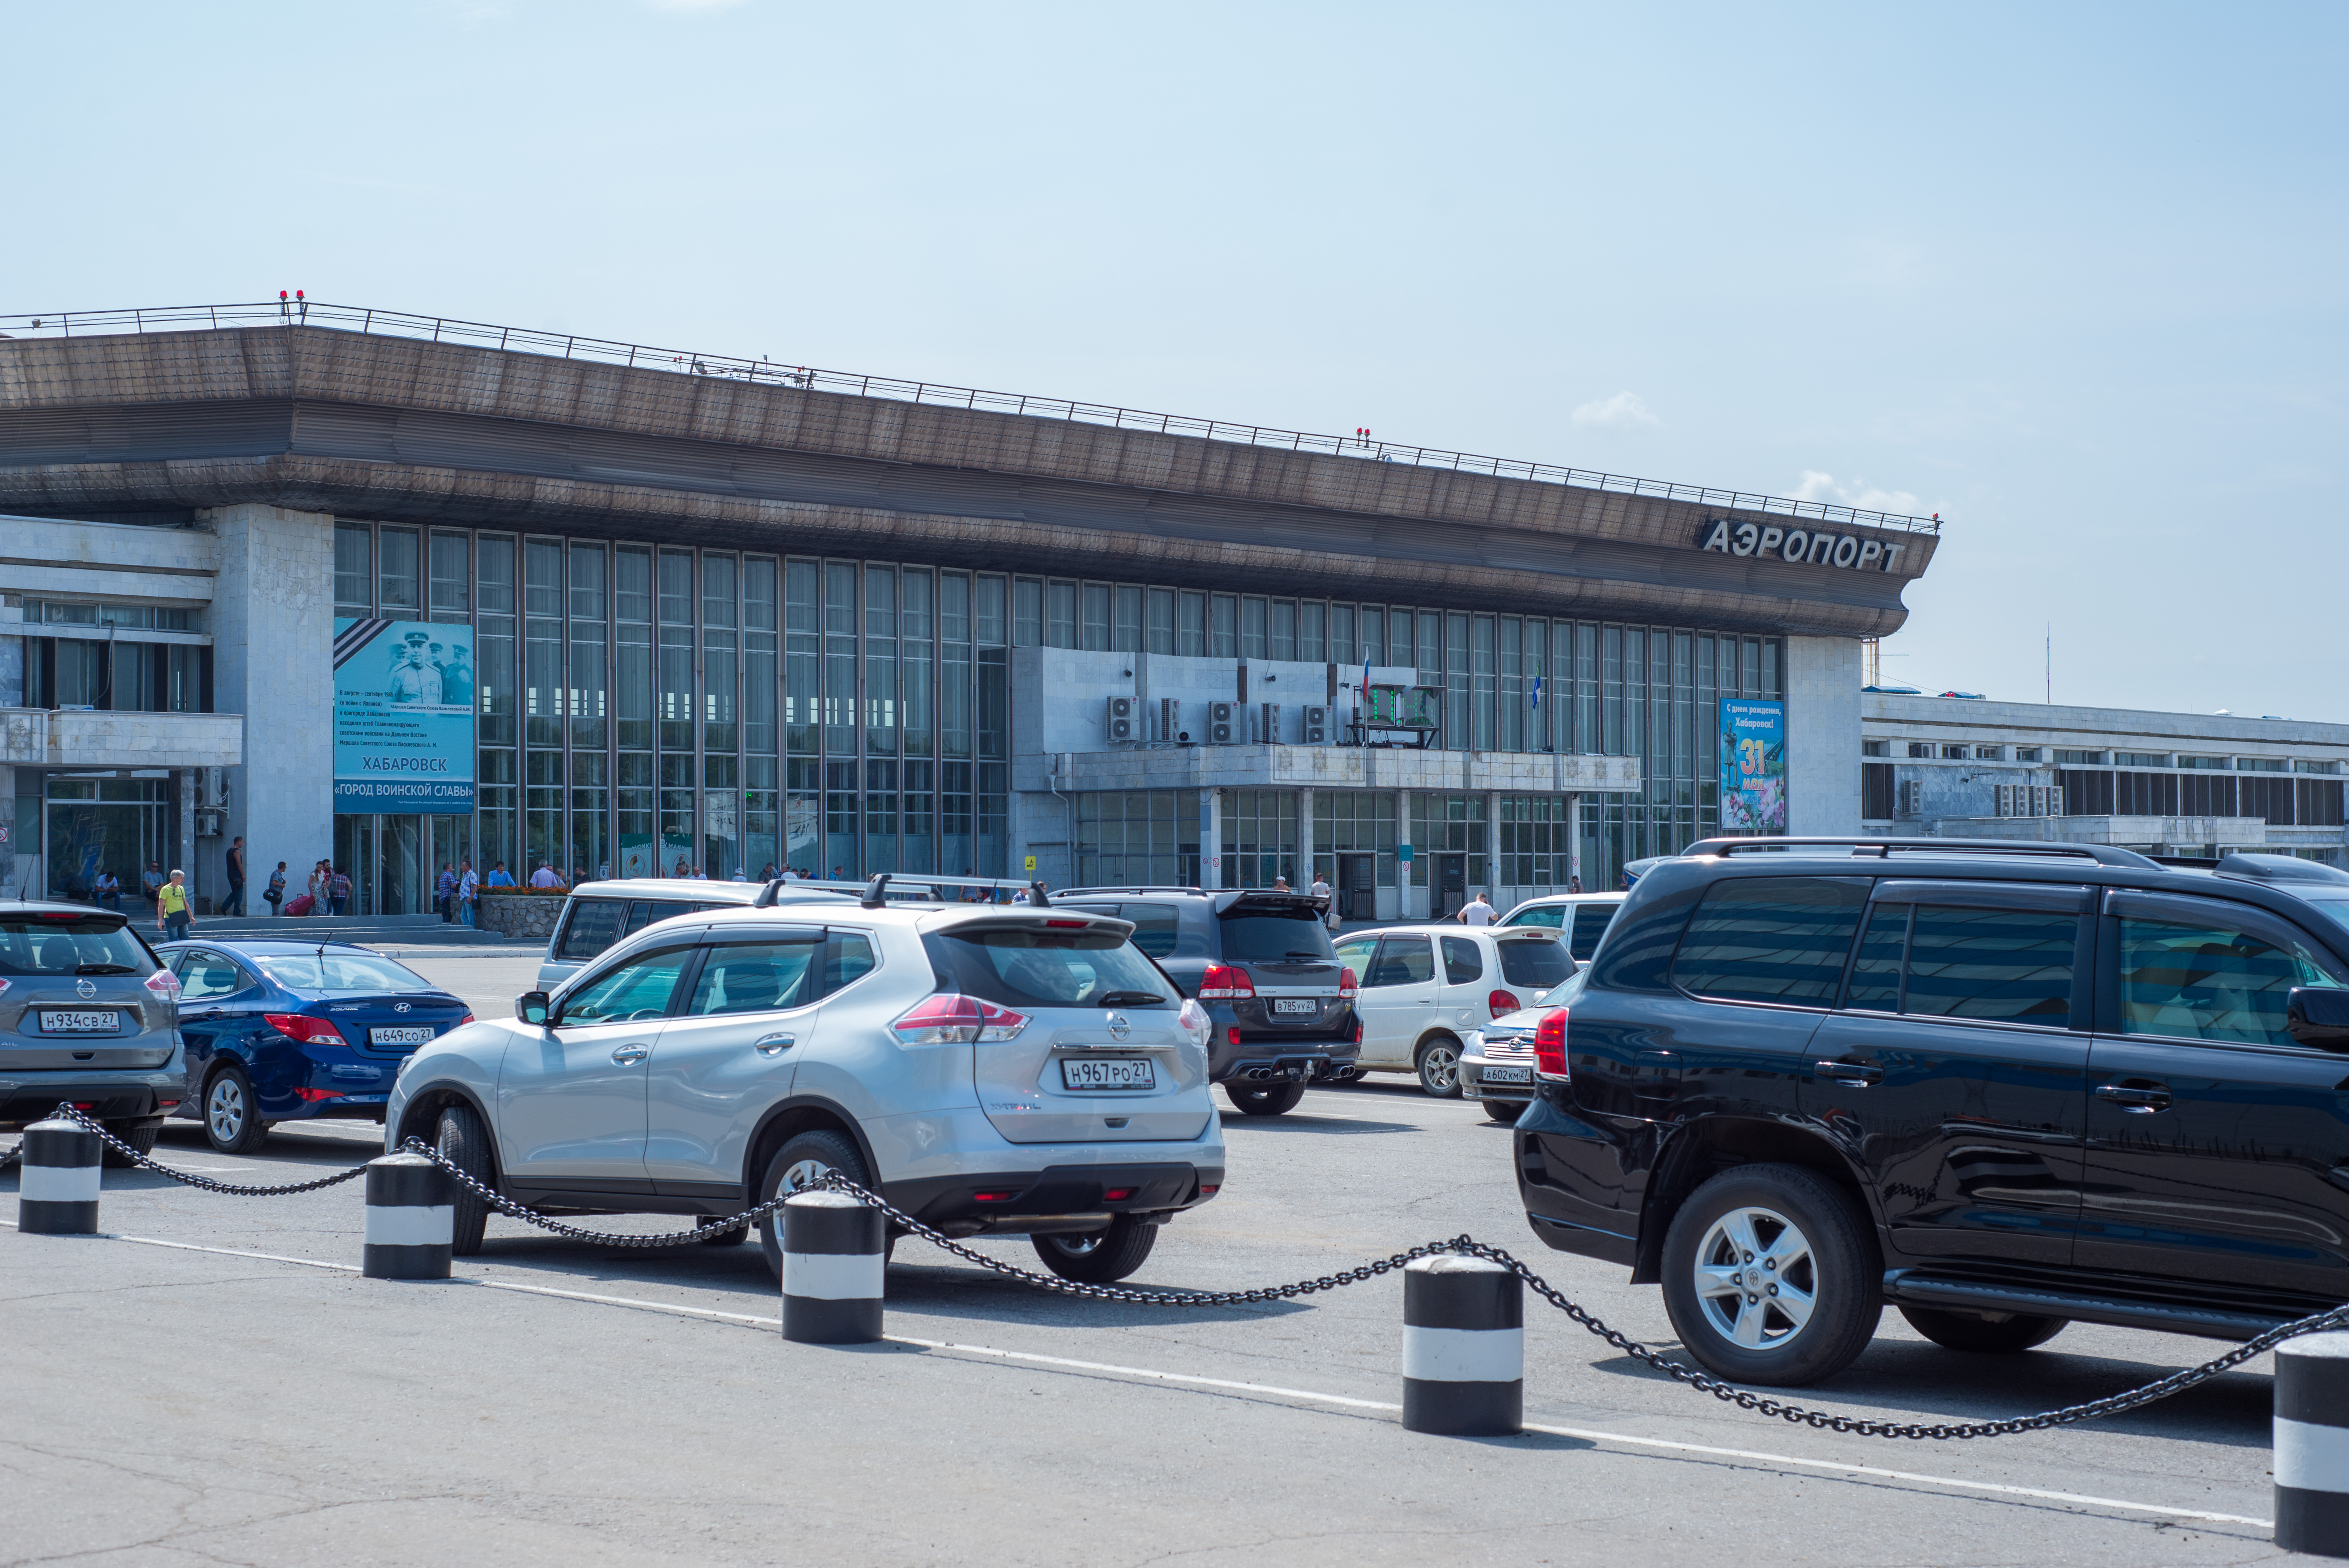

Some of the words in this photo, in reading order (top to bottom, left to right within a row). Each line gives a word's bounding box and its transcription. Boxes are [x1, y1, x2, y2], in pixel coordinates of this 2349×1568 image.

[1701, 519, 1905, 572] АЭРОПОРТ
[1727, 704, 1731, 712] С
[1749, 707, 1781, 716] рождения,
[1735, 717, 1774, 730] Хабаровск!
[1740, 738, 1764, 775] 31
[362, 757, 448, 772] ХАБАРОВСК
[334, 784, 374, 797] «ГОРОД
[377, 783, 431, 796] ВОИНСКОЙ
[434, 785, 473, 797] СЛАВЫ»
[1742, 778, 1764, 790] мая
[1747, 796, 1761, 805] 1858
[632, 843, 652, 852] MONKE
[102, 1013, 114, 1024] 27
[421, 1029, 430, 1038] 27
[1133, 1063, 1145, 1077] 27
